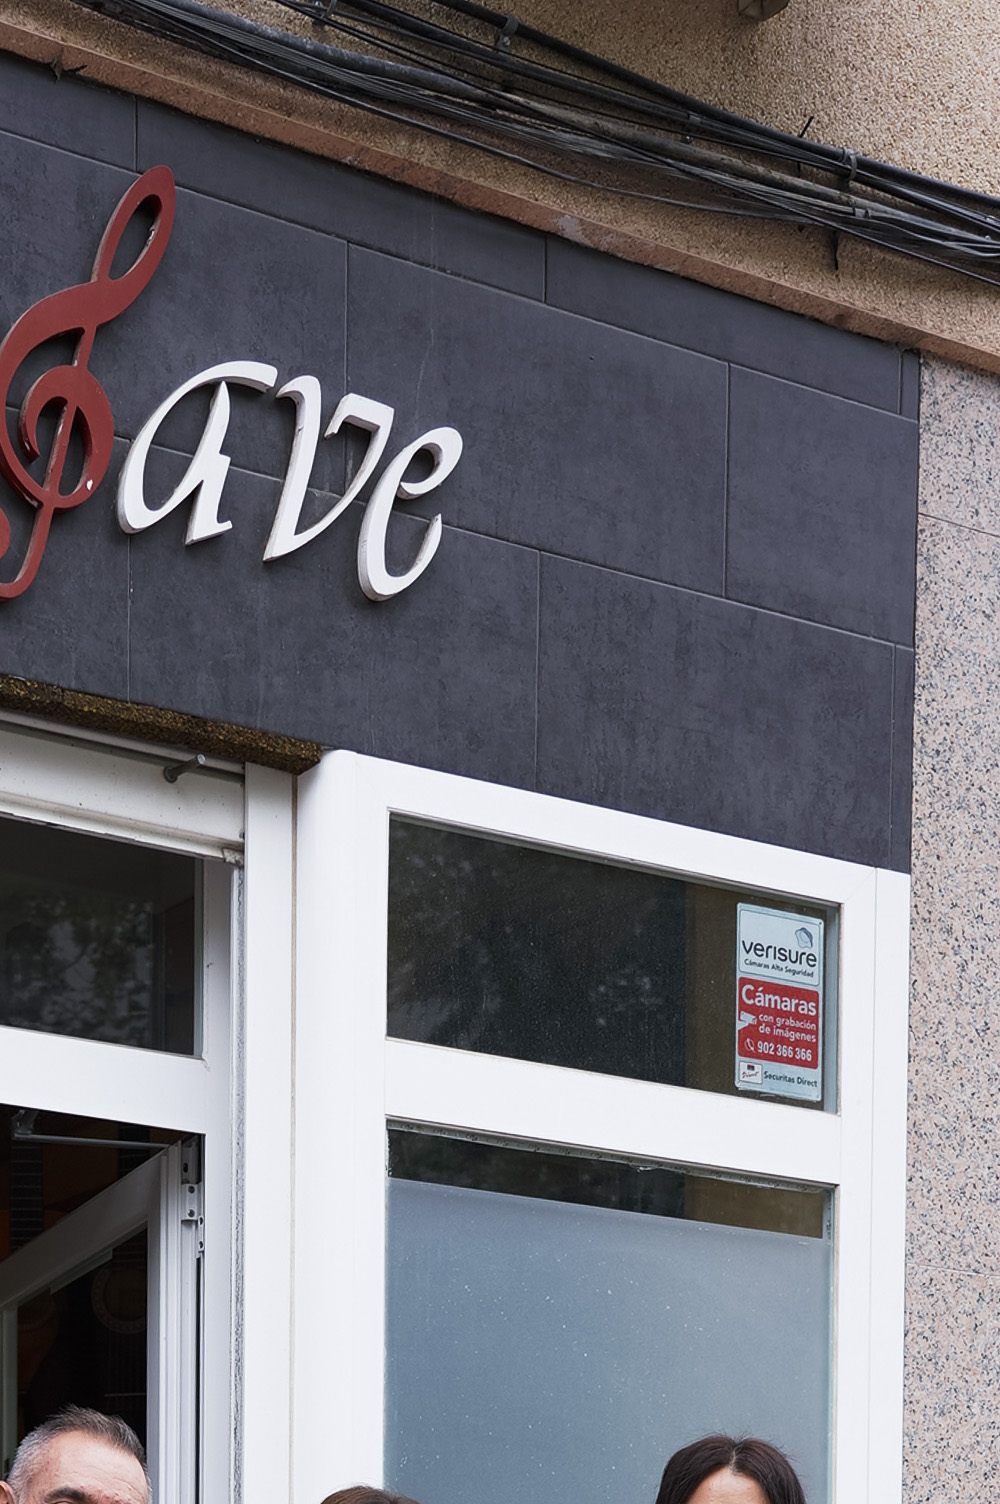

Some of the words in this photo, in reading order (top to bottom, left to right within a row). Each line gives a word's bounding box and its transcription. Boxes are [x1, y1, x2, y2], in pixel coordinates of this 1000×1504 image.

[741, 939, 818, 968] verisure
[744, 958, 770, 970] Cámaras
[771, 962, 784, 972] Alta
[785, 965, 814, 979] Seguridad
[741, 984, 817, 1016] Cámaras
[758, 1013, 774, 1023] con
[775, 1016, 817, 1031] grabación
[758, 1023, 772, 1035] de
[773, 1026, 817, 1043] imágenes
[757, 1041, 775, 1056] 902
[776, 1044, 794, 1059] 366
[795, 1047, 812, 1062] 366
[764, 1071, 795, 1084] Securitas
[797, 1076, 818, 1088] Direct
